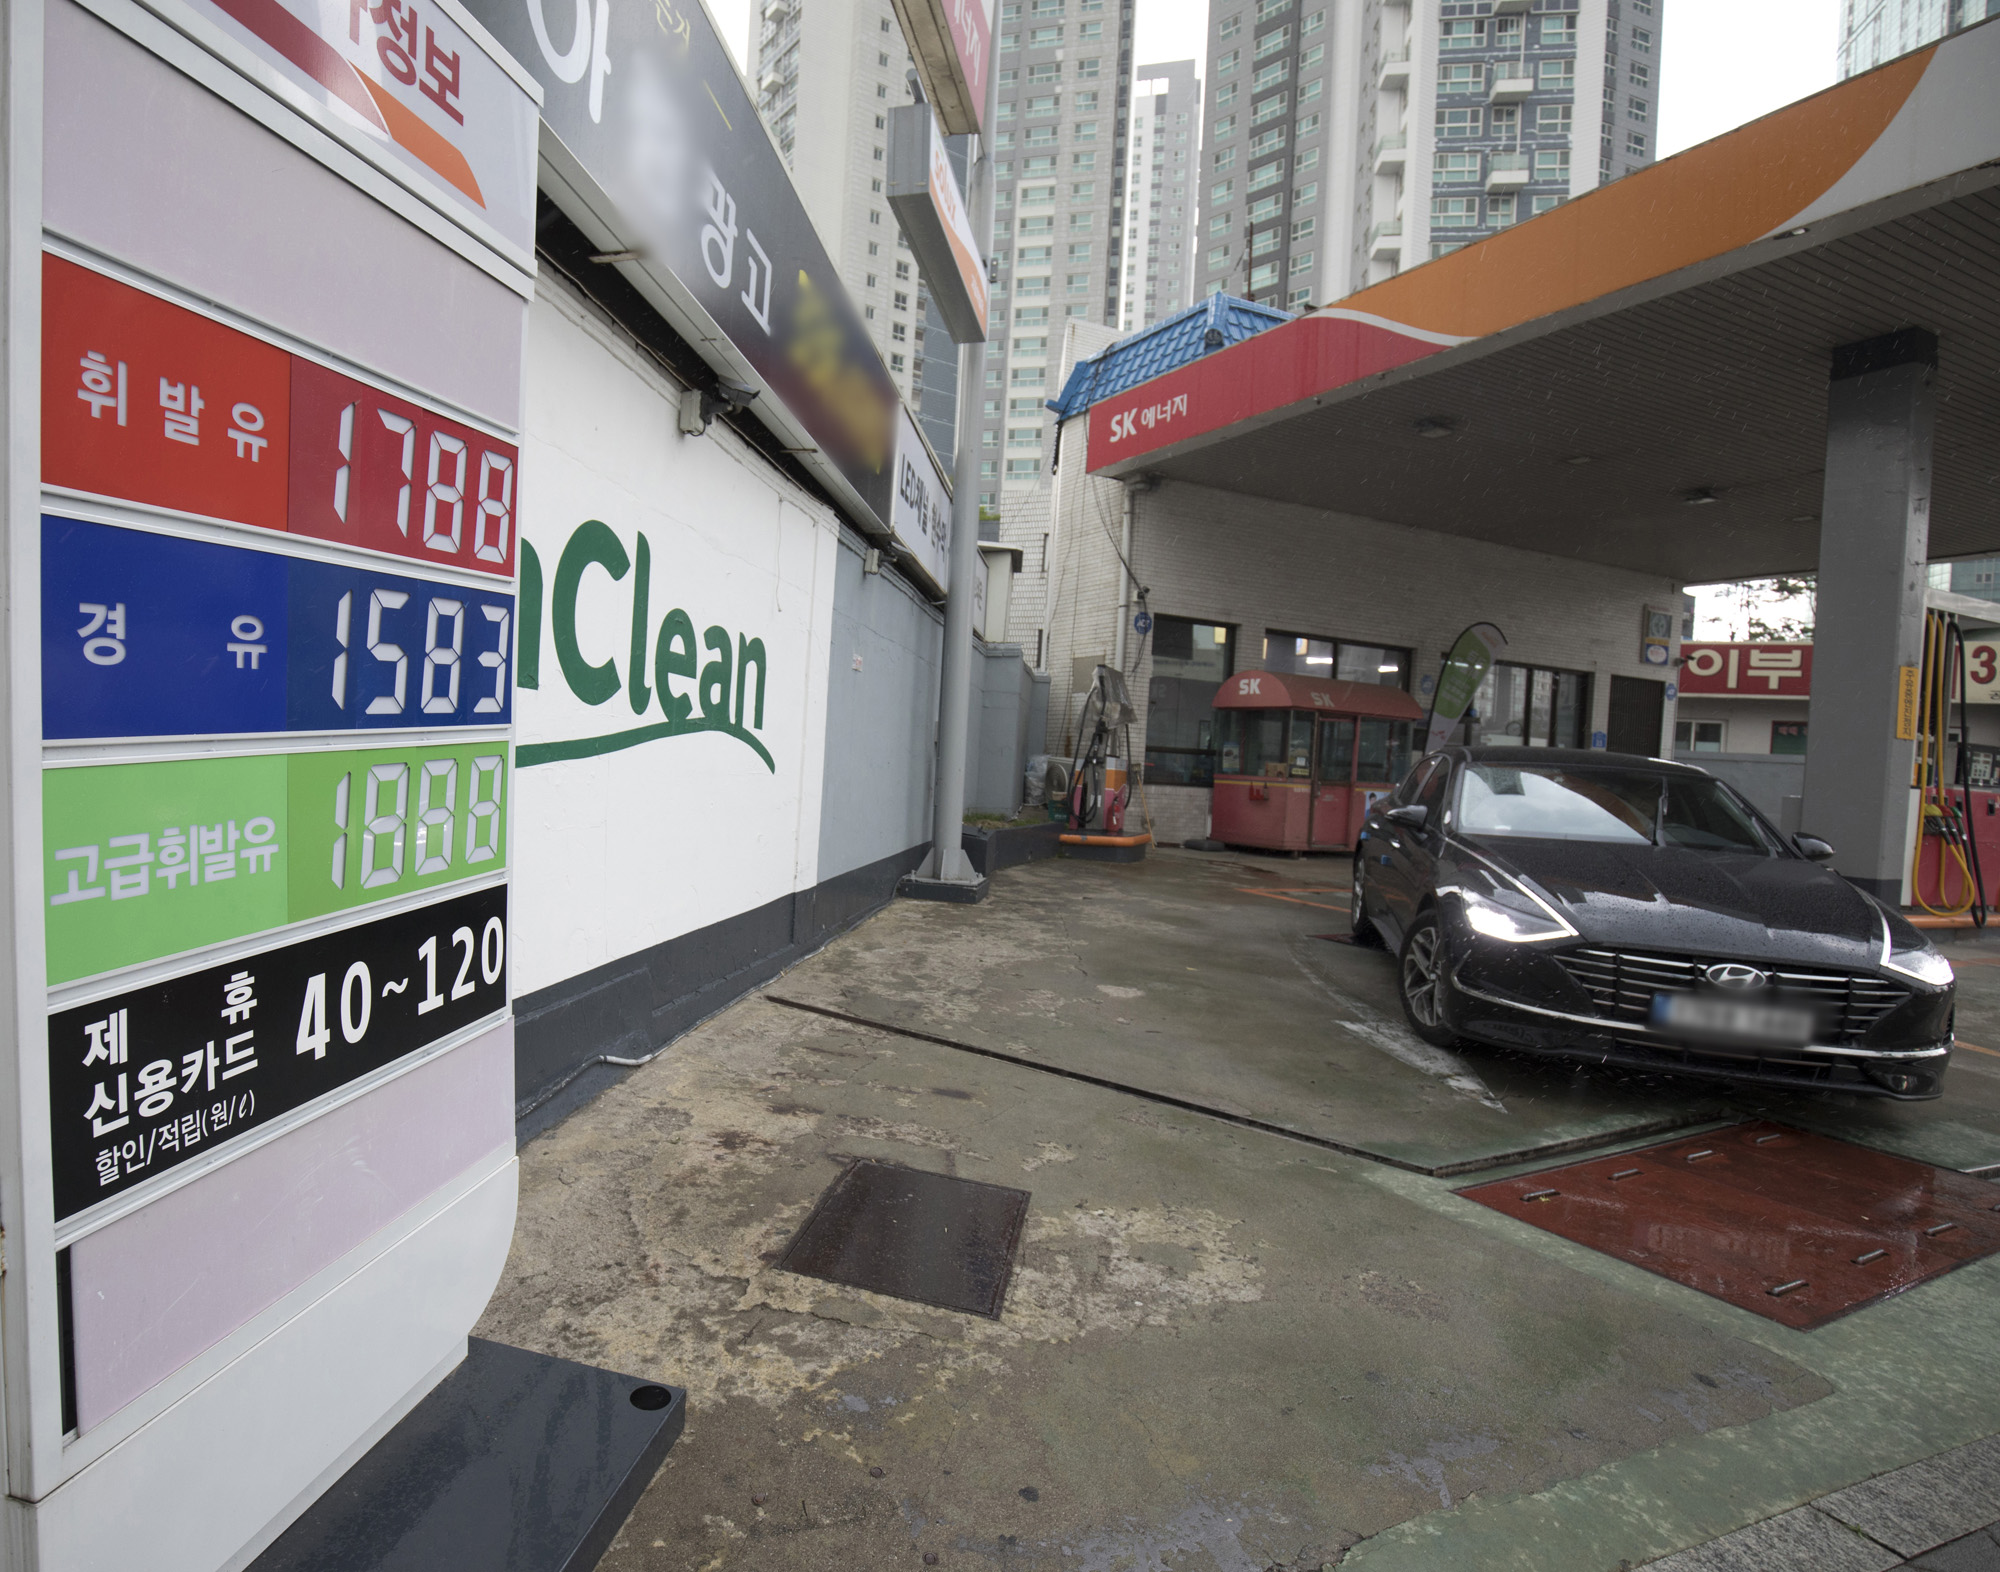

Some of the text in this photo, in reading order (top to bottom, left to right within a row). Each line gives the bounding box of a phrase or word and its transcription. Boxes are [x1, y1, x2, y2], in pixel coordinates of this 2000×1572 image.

[1109, 393, 1187, 443] SK 에너지
[333, 402, 513, 564] 1788
[331, 588, 510, 715] 1583
[1239, 678, 1261, 695] SK
[1969, 645, 1997, 685] 3
[1310, 691, 1335, 707] SK
[50, 755, 504, 906] 고급휘발유 1888
[83, 1030, 258, 1138] 신용카드
